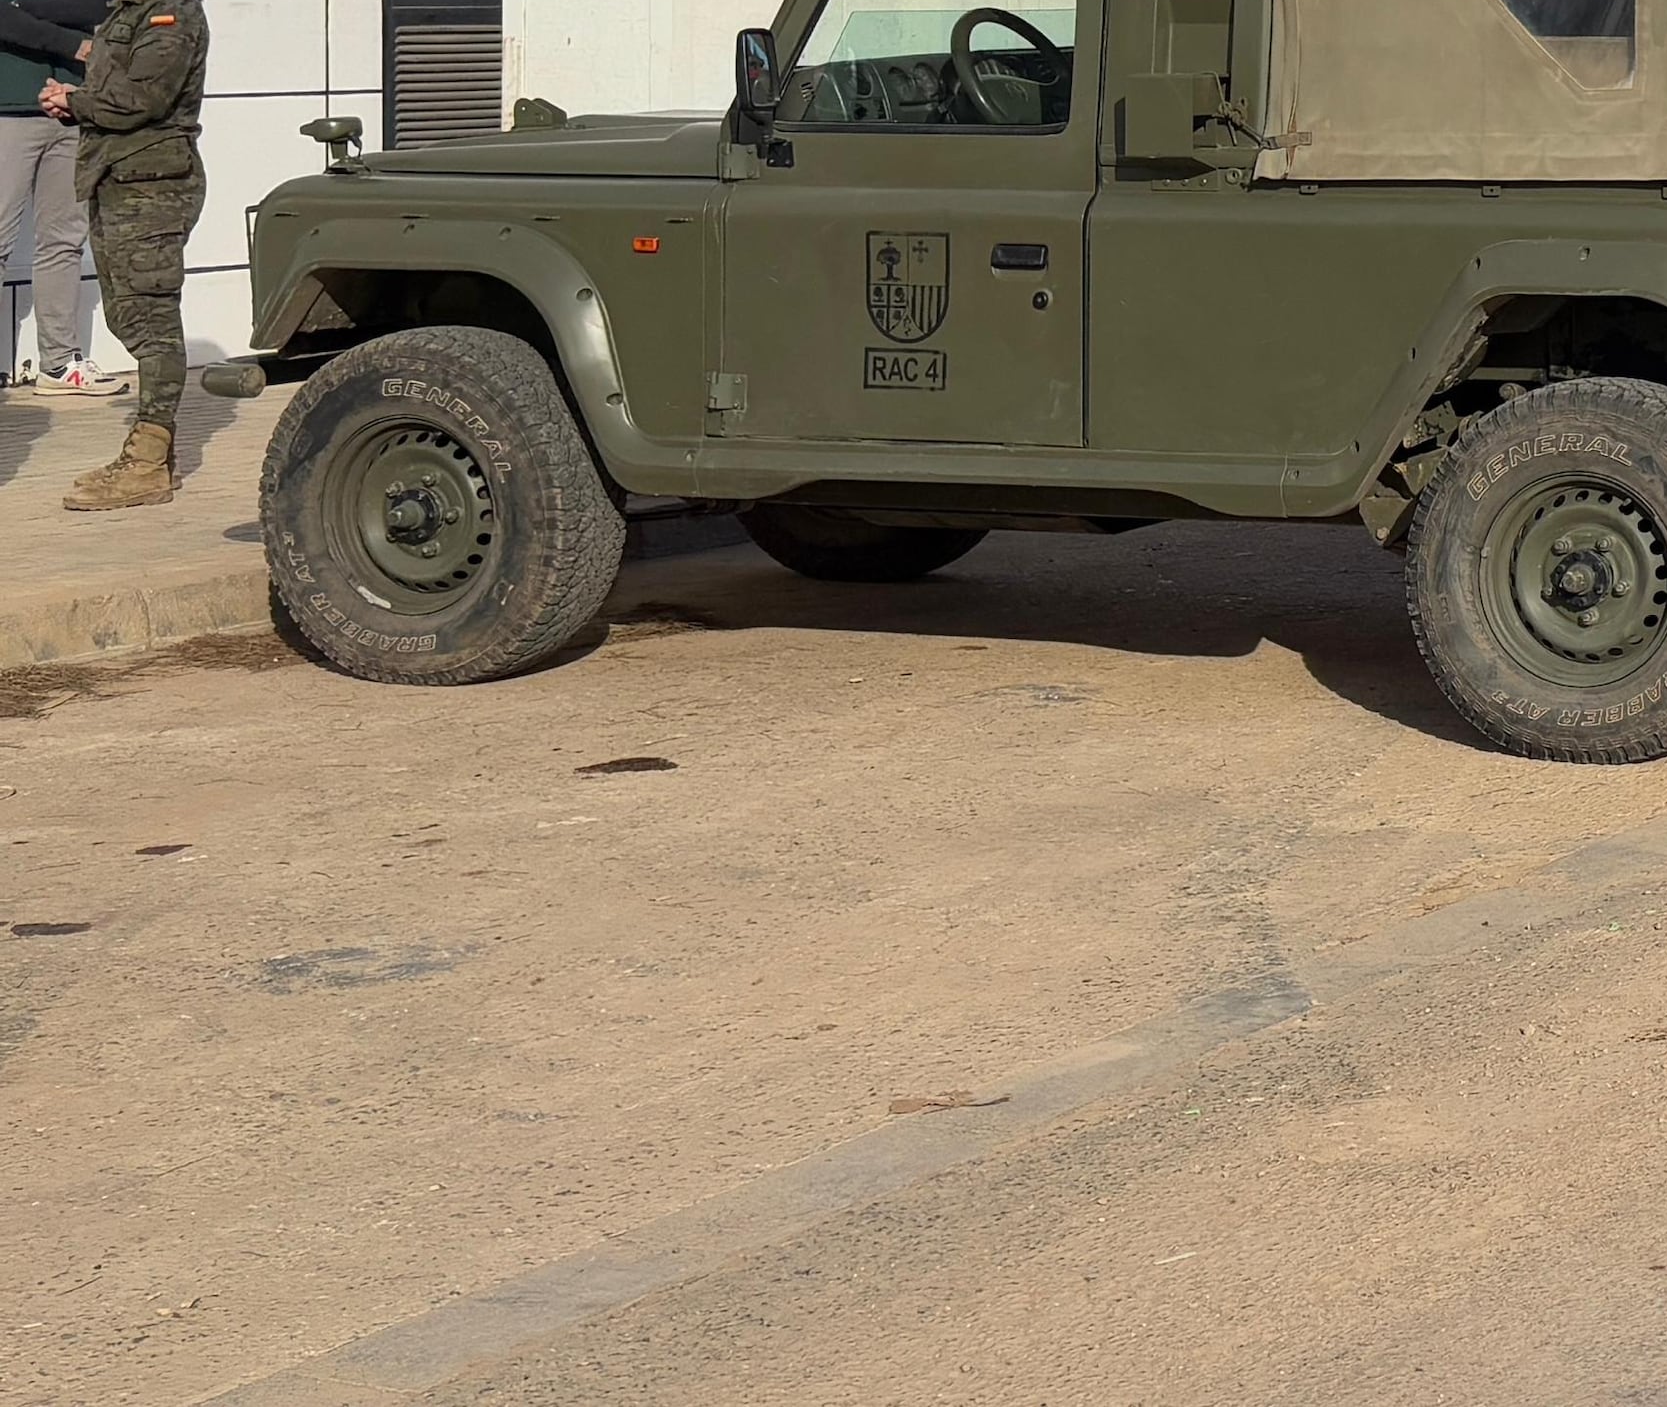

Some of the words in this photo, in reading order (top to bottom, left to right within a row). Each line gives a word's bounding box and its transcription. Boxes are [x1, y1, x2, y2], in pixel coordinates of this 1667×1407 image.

[872, 355, 919, 383] RAC
[924, 357, 940, 384] 4
[383, 378, 513, 485] GENERAL
[1466, 432, 1634, 501] GENERAL
[310, 590, 437, 652] GRABBER
